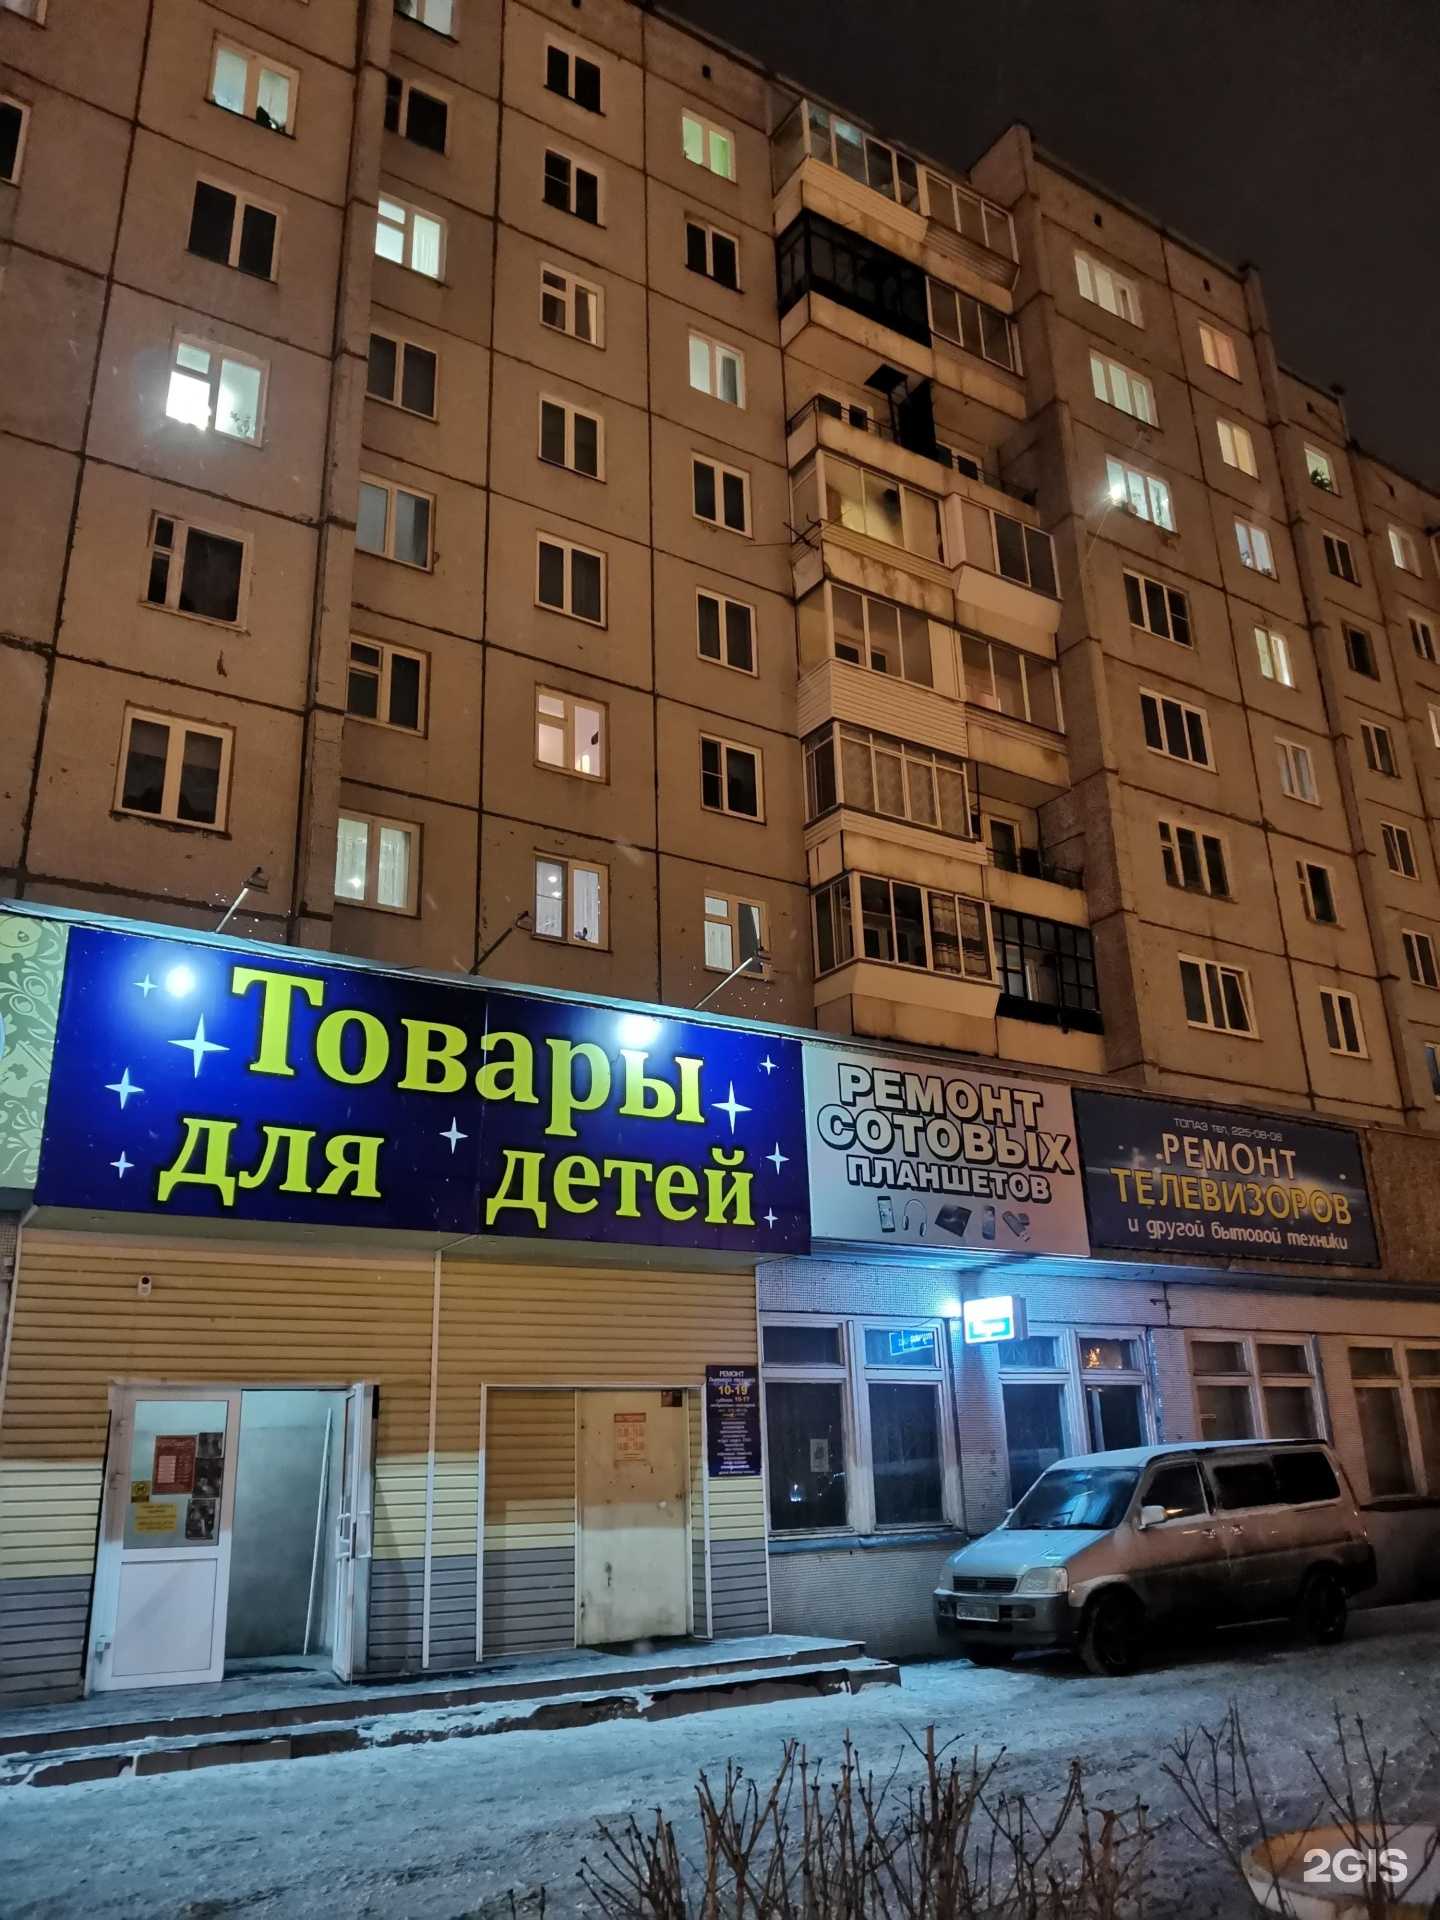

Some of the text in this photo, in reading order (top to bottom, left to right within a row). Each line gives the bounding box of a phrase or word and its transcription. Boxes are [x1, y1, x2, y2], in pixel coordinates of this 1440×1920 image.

[231, 966, 706, 1137] Товары
[838, 1063, 1042, 1131] РЕМОНТ
[817, 1104, 1074, 1174] СОТОВЫХ
[1174, 1117, 1208, 1131] ТОПАЗ
[157, 1117, 756, 1229] для детей
[847, 1155, 1051, 1203] ПЛАНШЕТОВ
[1161, 1133, 1296, 1180] РЕМОНТ
[1110, 1167, 1352, 1225] ТЕЛЕВИЗОРОВ
[1128, 1217, 1349, 1250] и другой бытовой техники
[718, 1384, 748, 1395] 10-19
